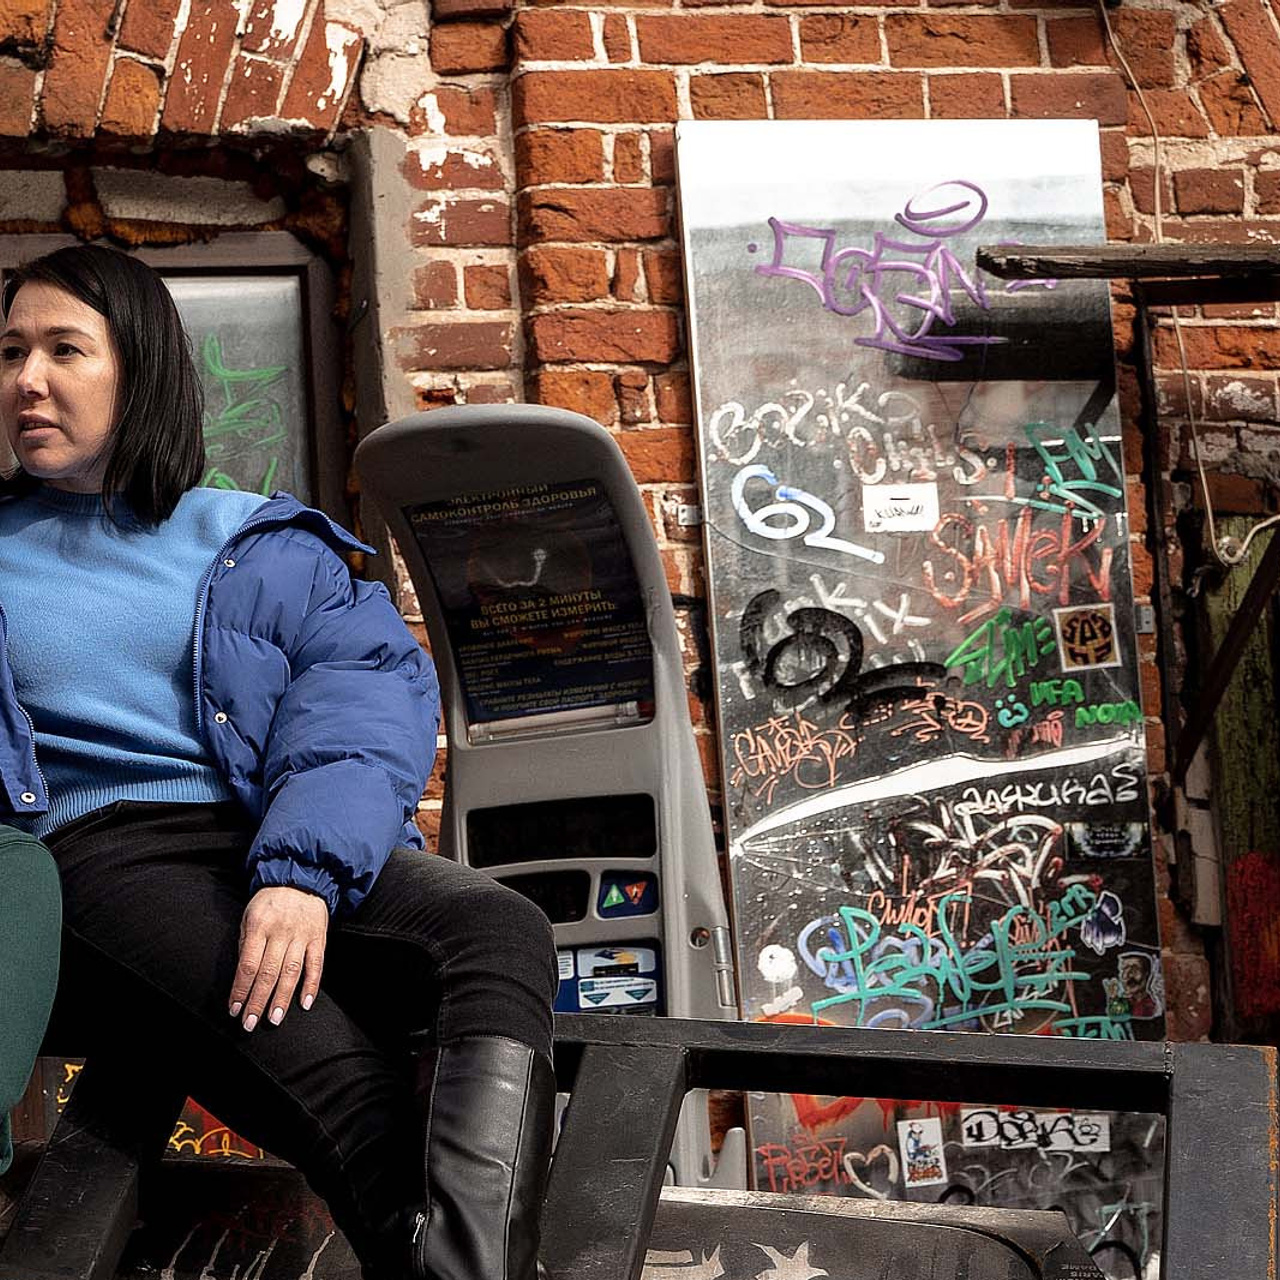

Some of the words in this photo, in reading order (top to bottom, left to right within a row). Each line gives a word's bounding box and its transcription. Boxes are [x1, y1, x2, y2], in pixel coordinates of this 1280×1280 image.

[522, 487, 597, 507] ЗДОРОВЬЯ
[470, 618, 490, 630] ВЫ
[492, 610, 549, 626] СМОЖЕТЕ
[551, 602, 616, 619] ИЗМЕРИТЬ
[481, 602, 517, 616] ВСЕГО
[520, 600, 536, 611] ЗА
[539, 599, 548, 608] 2
[549, 590, 602, 606] МИНУТЫ
